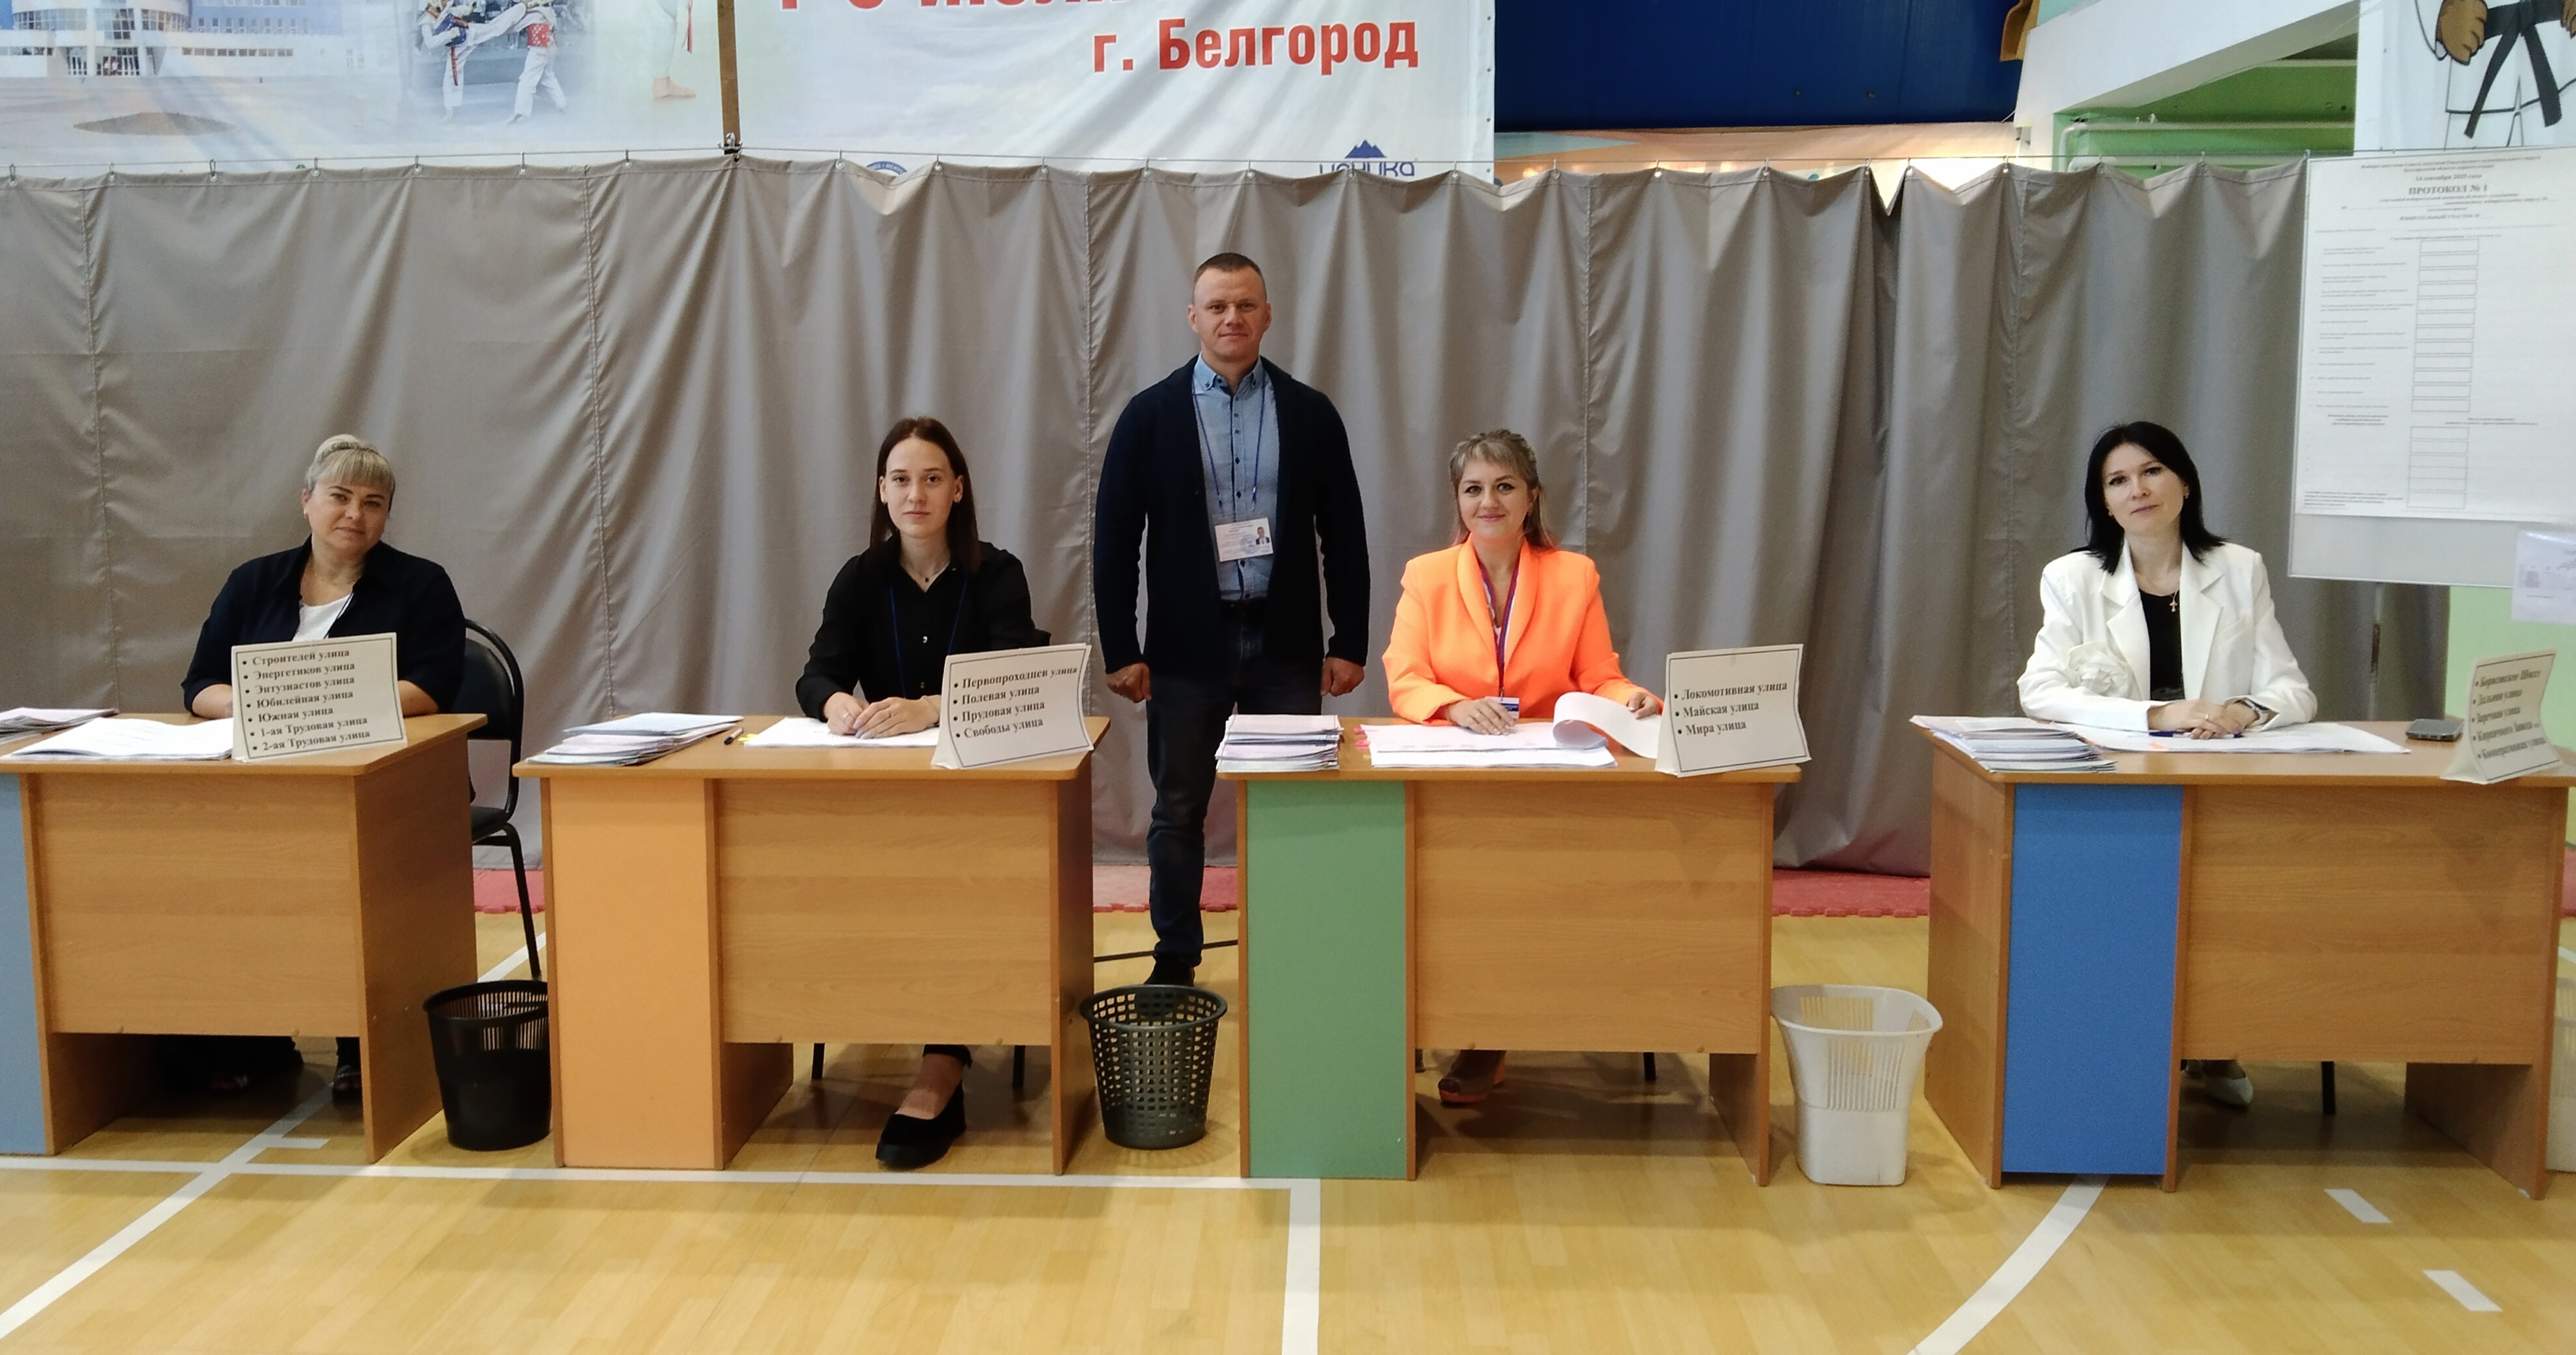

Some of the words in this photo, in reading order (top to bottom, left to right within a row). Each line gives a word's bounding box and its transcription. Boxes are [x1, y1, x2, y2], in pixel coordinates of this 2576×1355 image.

[1094, 35, 1134, 72] г.
[1159, 18, 1419, 75] Белгород
[2409, 185, 2467, 195] ПРОТОКОЛ
[252, 652, 315, 666] Строителей
[318, 649, 350, 662] улица
[254, 667, 321, 681] Энергетиков
[324, 663, 354, 676] улица
[962, 670, 1048, 689] Первопроходцев
[1050, 666, 1077, 678] улица
[255, 681, 321, 695] Энтузиастов
[324, 678, 354, 689] улица
[962, 691, 1006, 705] Полевая
[1009, 686, 1040, 700] улица
[1682, 684, 1755, 700] Локомотивная
[1757, 683, 1788, 696] улица
[257, 695, 320, 709] Юбилейная
[323, 691, 353, 704] улица
[258, 711, 299, 723] Южная
[303, 708, 333, 720] улица
[962, 707, 1012, 723] Прудовая
[1015, 702, 1045, 716] улица
[1683, 704, 1727, 718] Майская
[1730, 702, 1759, 716] улица
[261, 727, 282, 737] 1-ая
[286, 721, 334, 736] Трудовая
[337, 717, 367, 730] улица
[964, 723, 1010, 738] Свободы
[1013, 718, 1043, 733] улица
[1686, 723, 1714, 736] Мира
[1718, 721, 1746, 735] улица
[262, 741, 285, 751] 2-ая
[288, 736, 337, 749] Трудовая
[340, 730, 370, 744] улица
